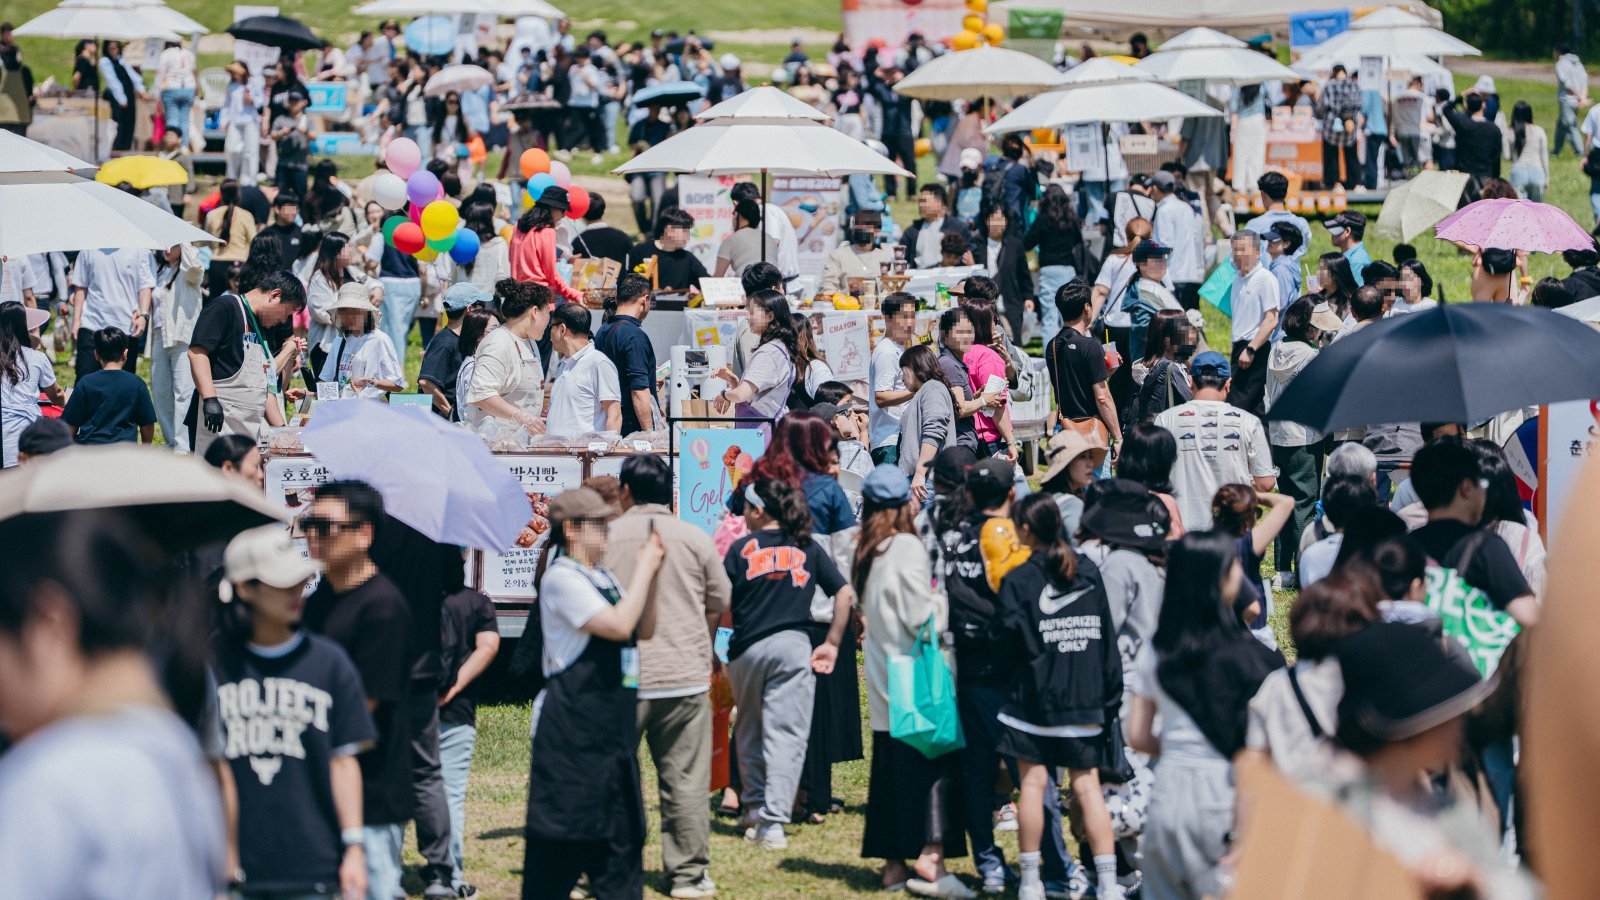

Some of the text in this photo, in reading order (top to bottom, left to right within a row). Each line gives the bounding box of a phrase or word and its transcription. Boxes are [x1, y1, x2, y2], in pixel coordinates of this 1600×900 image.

[829, 320, 857, 334] CRAYON
[690, 466, 733, 513] Gel
[1058, 638, 1089, 653] ONLY
[217, 676, 333, 733] ROJECT
[225, 718, 307, 760] ROCK
